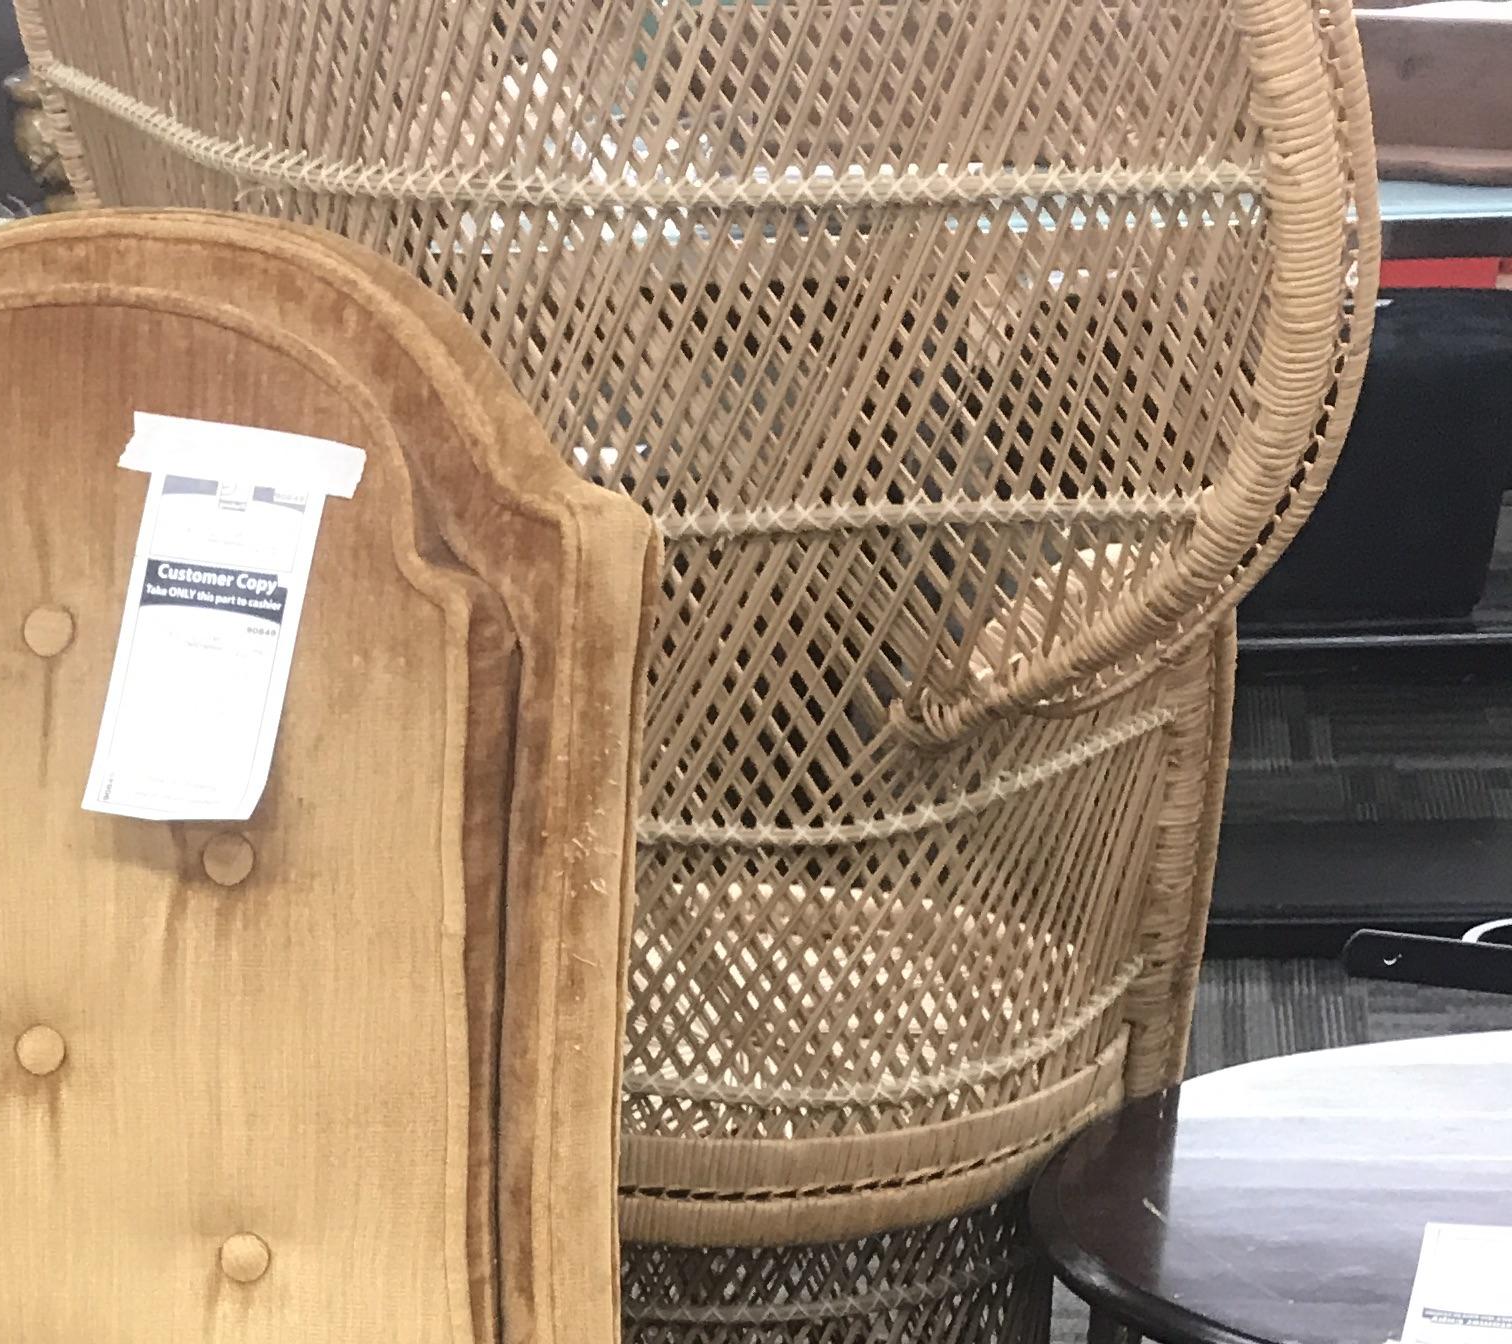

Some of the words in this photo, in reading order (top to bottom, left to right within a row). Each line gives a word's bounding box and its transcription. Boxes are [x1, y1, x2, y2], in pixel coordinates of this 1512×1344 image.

[157, 563, 234, 588] Customer
[236, 573, 278, 596] Copy
[146, 583, 168, 597] Take
[168, 586, 196, 600] ONLY
[196, 591, 214, 603] this
[214, 594, 235, 605] part
[236, 597, 247, 607] to
[248, 598, 282, 611] cashier
